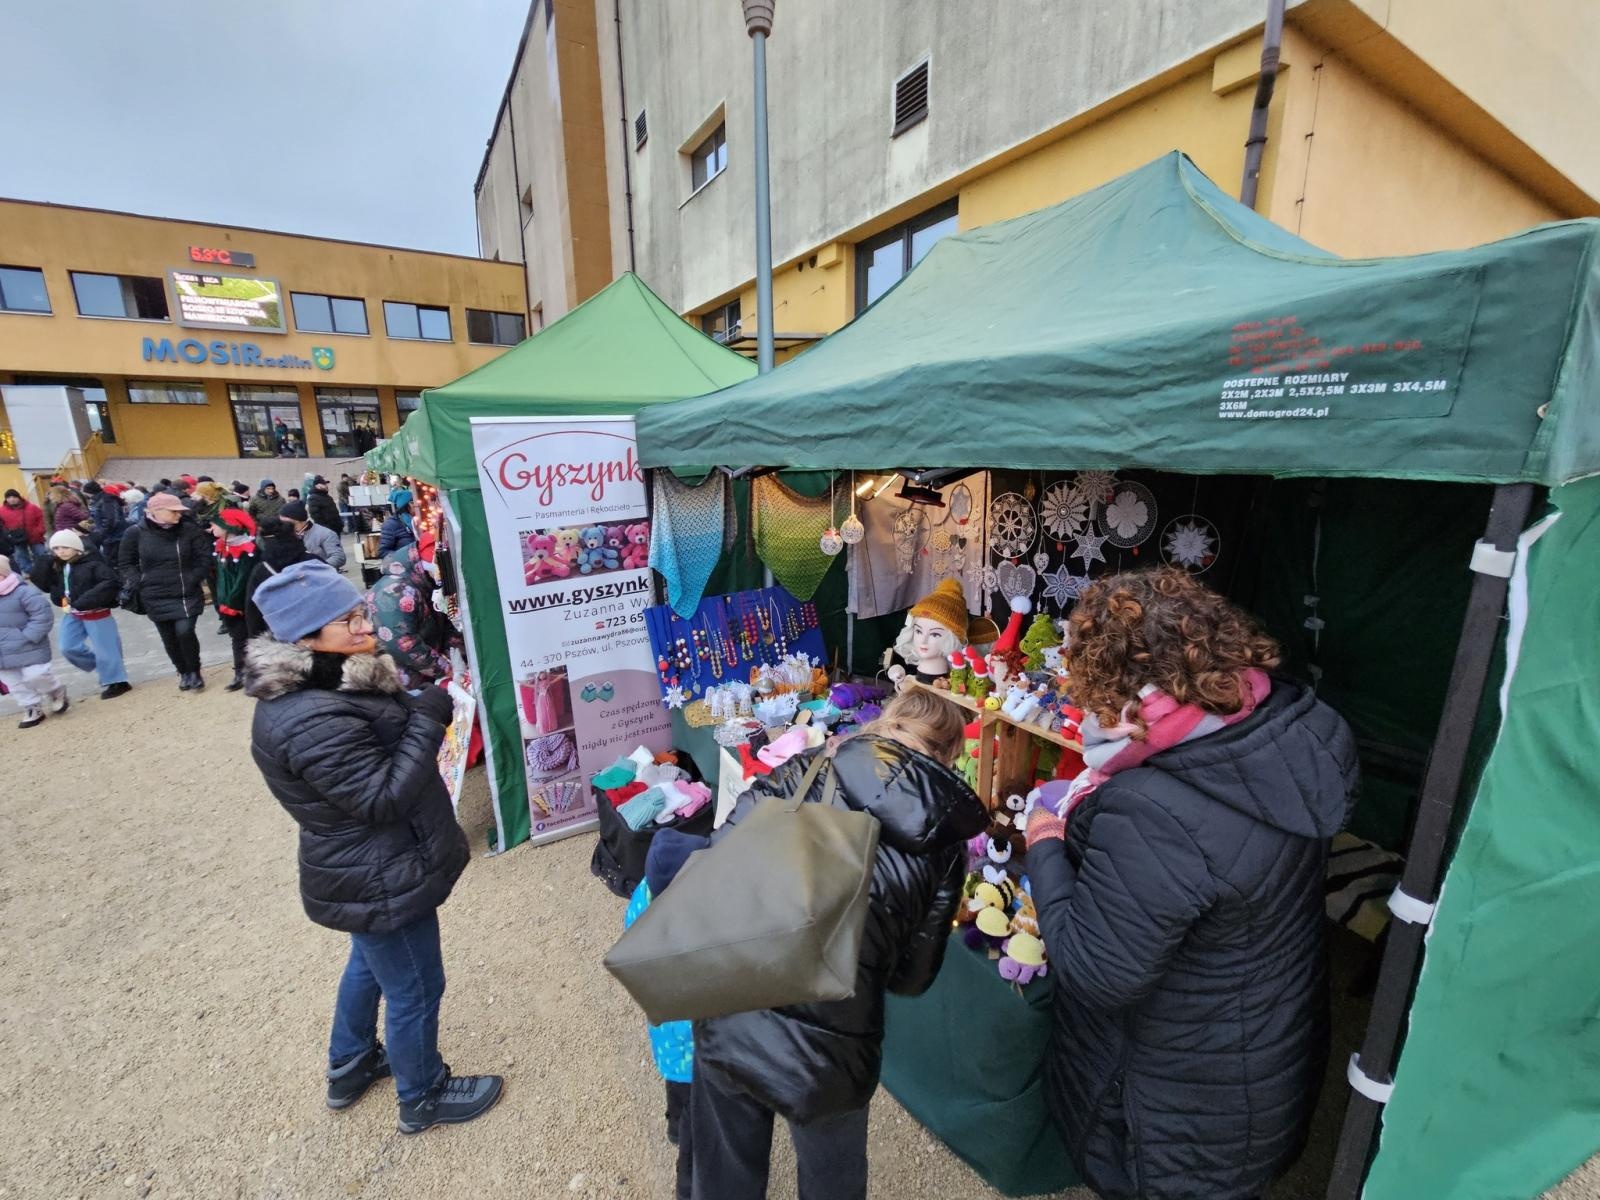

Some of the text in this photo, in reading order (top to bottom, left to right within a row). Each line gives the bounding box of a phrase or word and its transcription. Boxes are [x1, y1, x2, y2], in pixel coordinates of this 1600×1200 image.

[1223, 372, 1349, 388] DOSTEPNE ROZMIARY
[1289, 385, 1344, 397] 2,5X2,5M
[1350, 383, 1387, 394] 3X3M
[1393, 380, 1447, 392] 3X4,5M
[1219, 401, 1248, 411] 3X6M
[1219, 407, 1329, 418] www.domogrod24.pl
[535, 507, 585, 519] Pasmanteria
[590, 503, 631, 514] Rękodzieło
[563, 602, 625, 621] Zuzanna
[605, 612, 644, 628] 723 65
[520, 659, 534, 668] 44
[543, 652, 562, 664] 370
[565, 647, 599, 659] Pszów,
[599, 699, 661, 719] Czas spędzony
[617, 711, 655, 728] Gyszynk
[582, 738, 608, 750] nigdy
